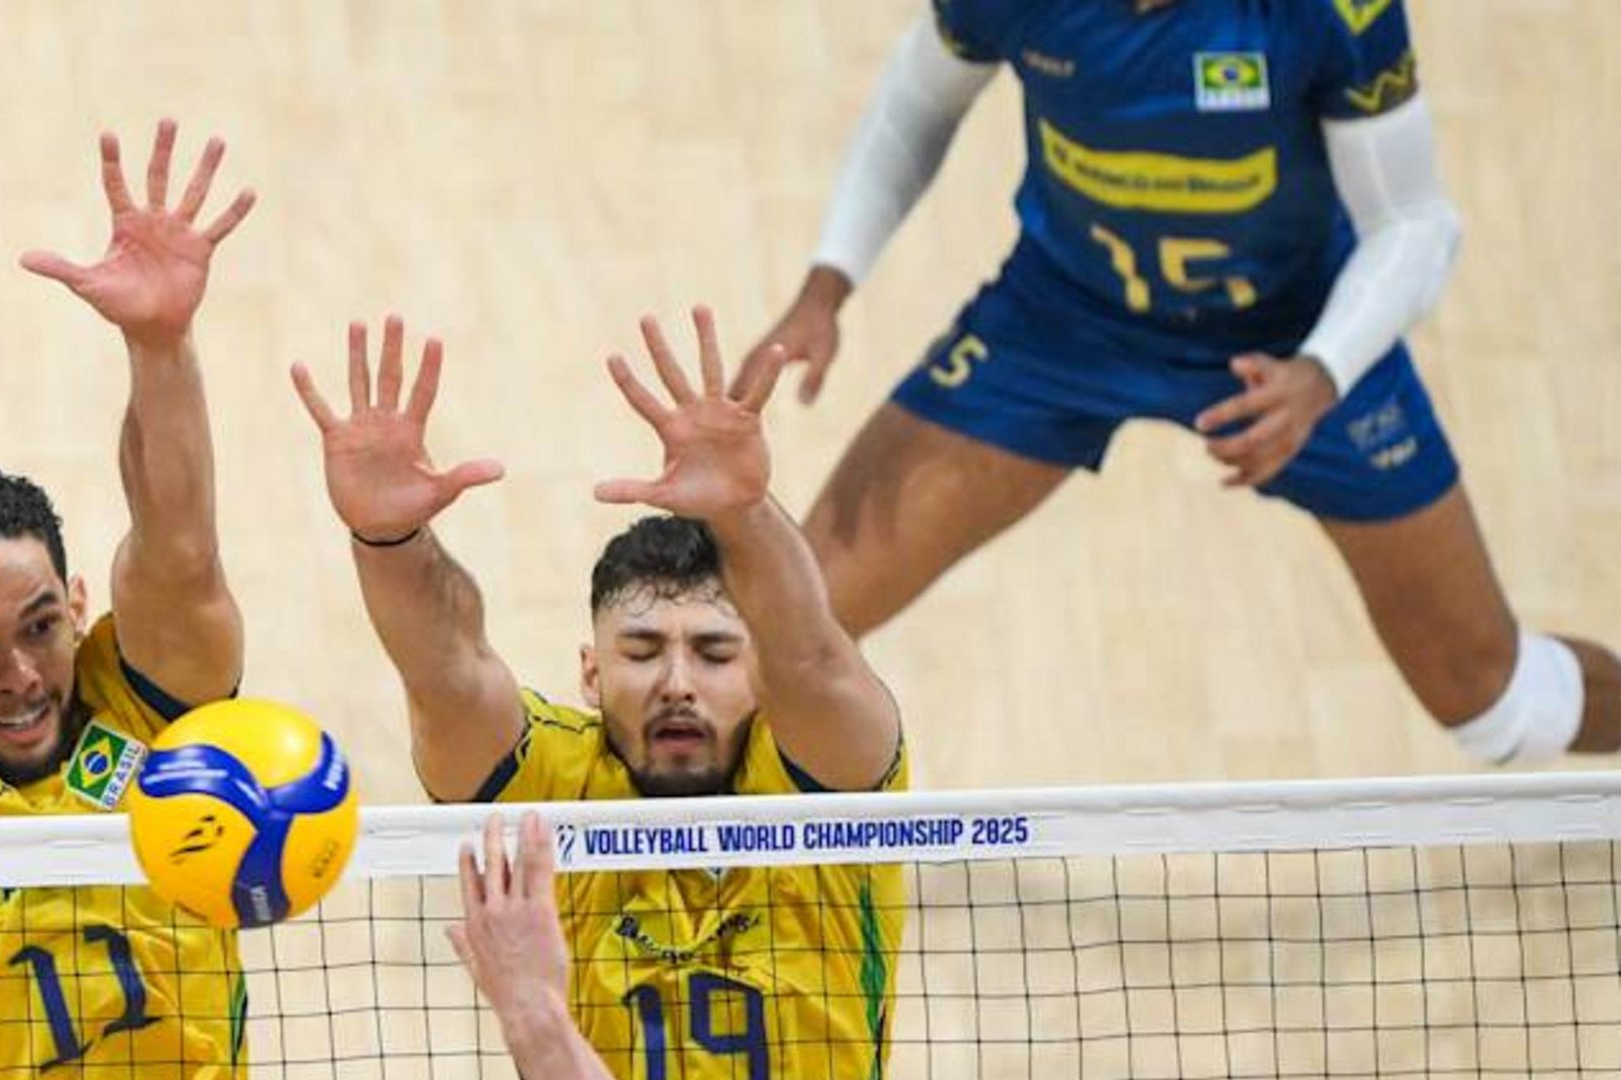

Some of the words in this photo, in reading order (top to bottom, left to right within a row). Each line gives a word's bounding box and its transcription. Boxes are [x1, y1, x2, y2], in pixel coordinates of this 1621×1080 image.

[1089, 224, 1257, 312] 15
[584, 827, 707, 857] VOLLEYBALL
[716, 824, 796, 853] WORLD
[803, 819, 964, 850] CHAMPIONSHIP
[971, 817, 1030, 846] 2025
[8, 925, 162, 1075] 11
